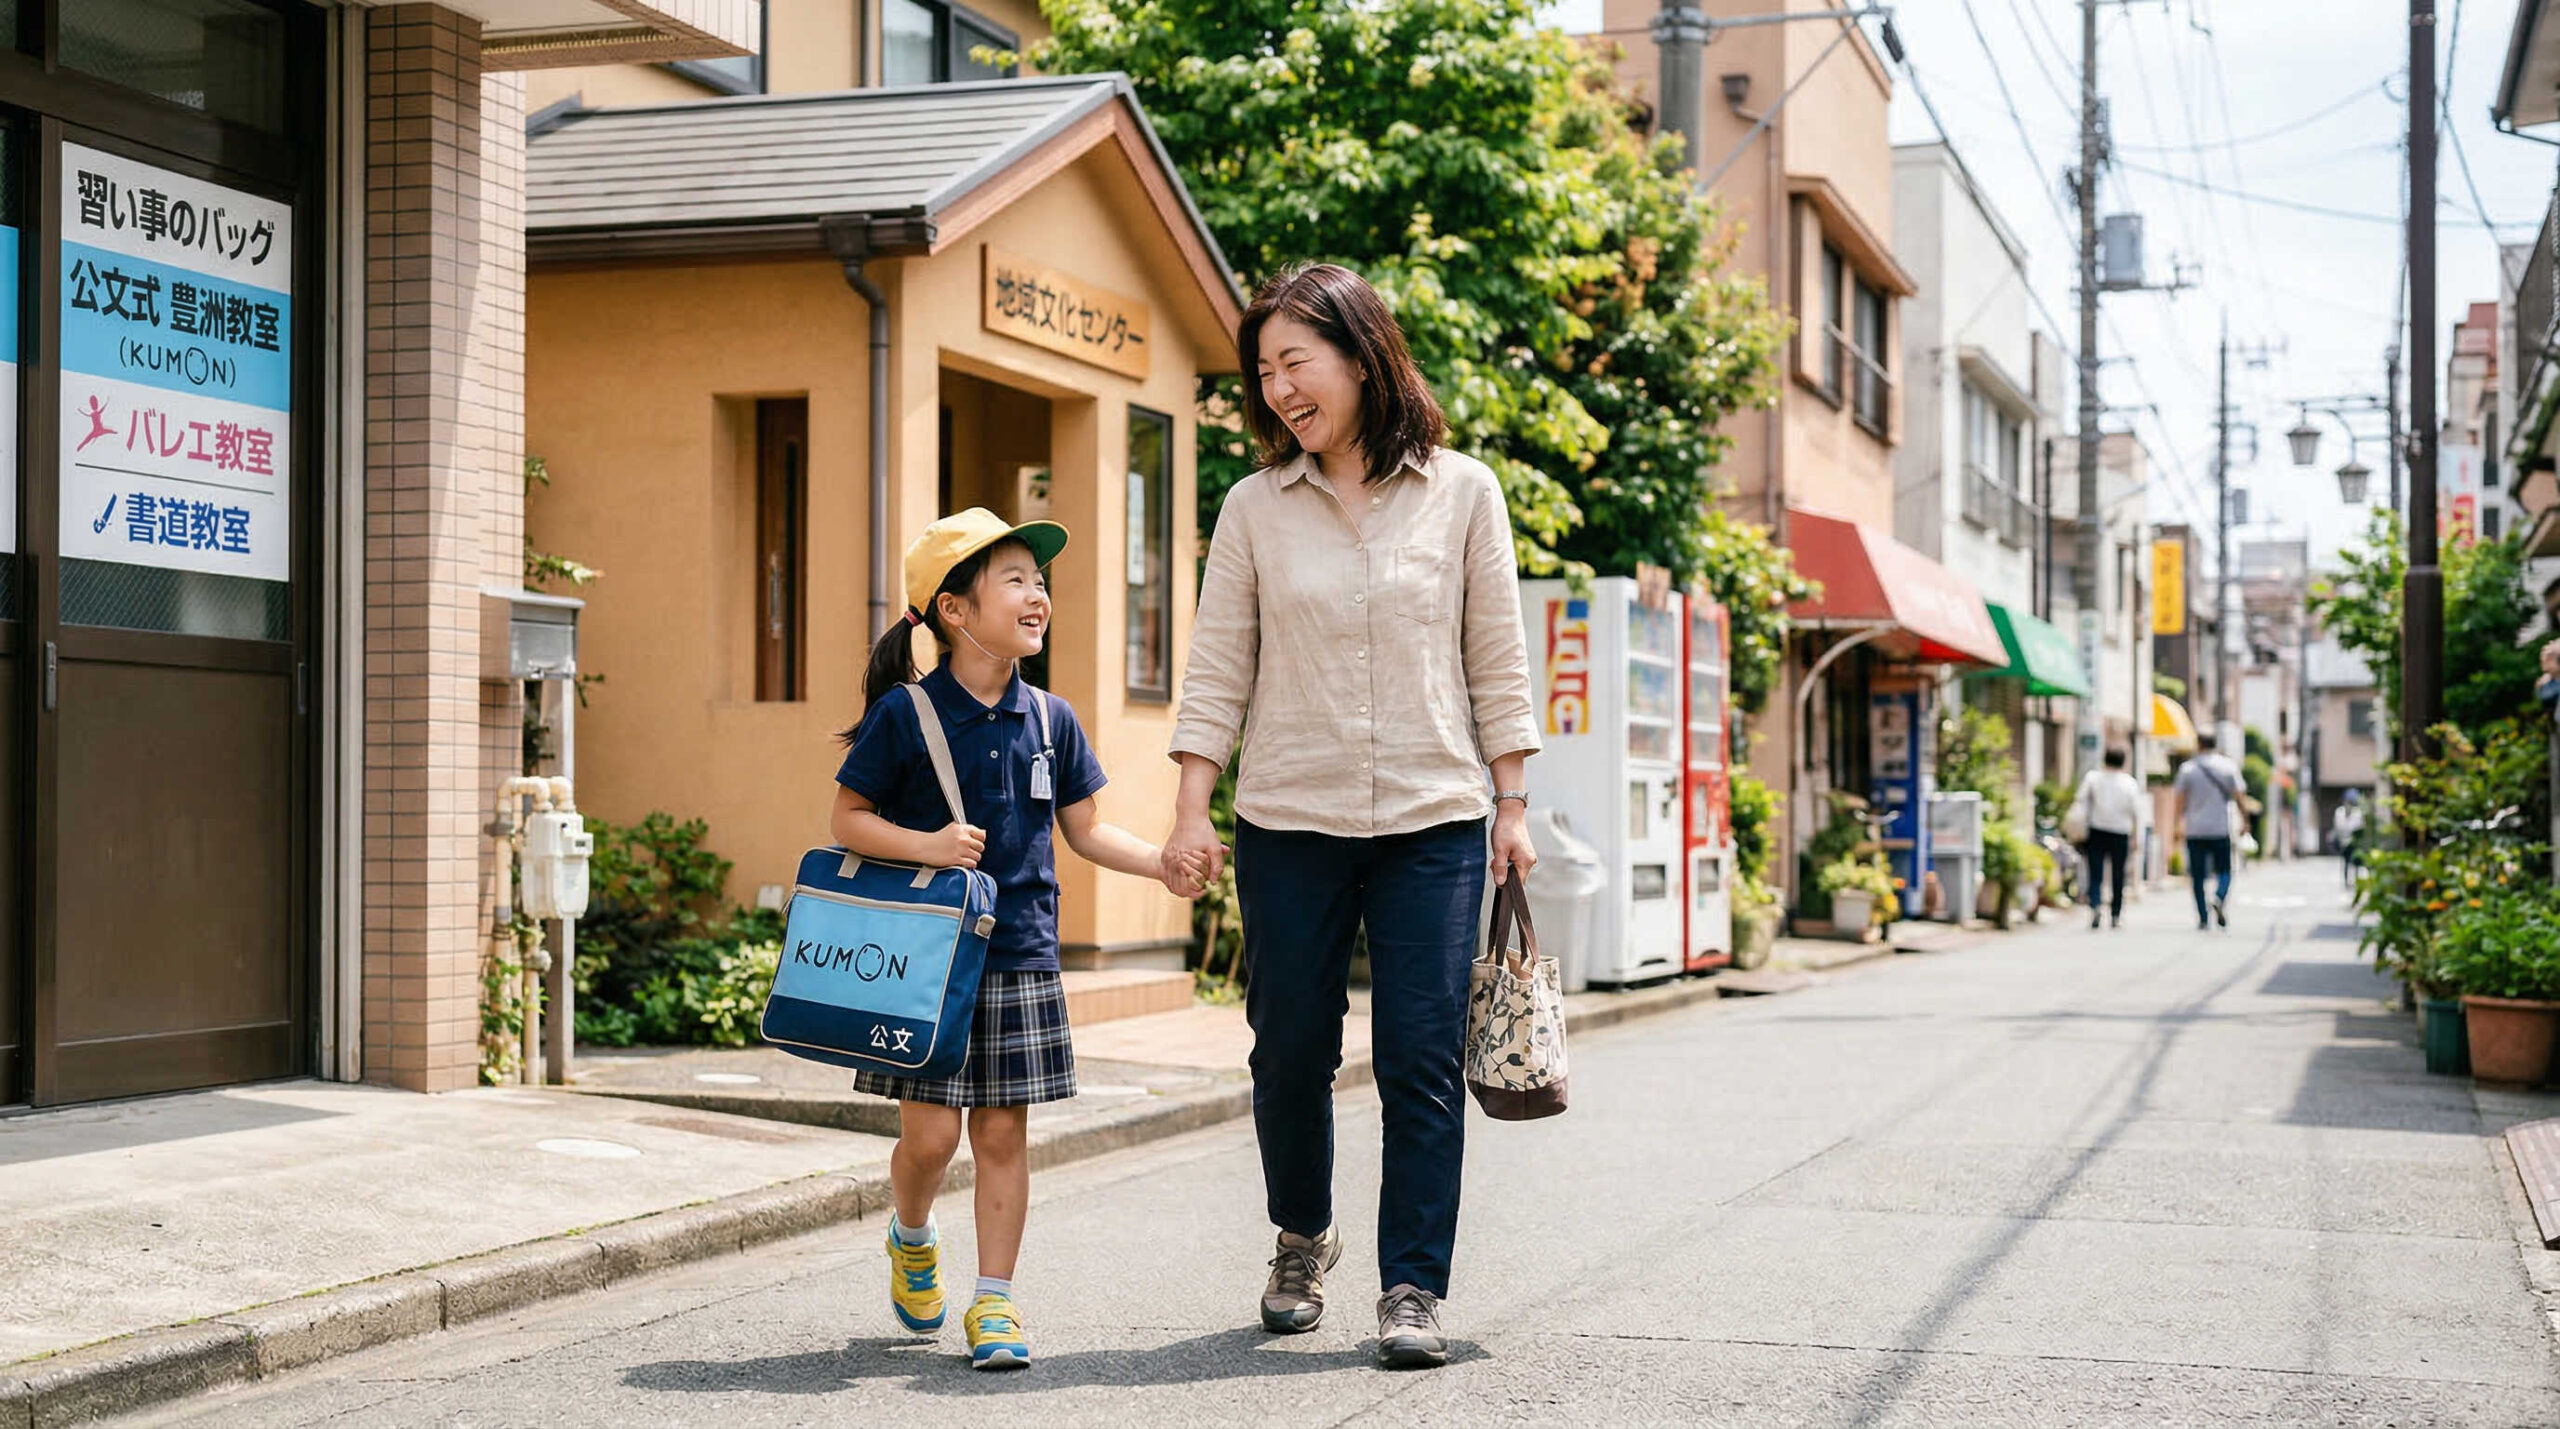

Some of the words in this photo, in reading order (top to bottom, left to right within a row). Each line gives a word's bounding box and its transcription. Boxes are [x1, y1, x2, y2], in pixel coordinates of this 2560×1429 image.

[77, 170, 275, 266] 習い事のバッグ
[70, 257, 161, 327] 公文式
[170, 282, 280, 353] 豊洲教室
[996, 267, 1143, 352] 地域文化センター
[126, 408, 274, 476] バレエ教室
[126, 492, 251, 555] 書道教室
[795, 940, 908, 982] KUMON
[870, 1024, 913, 1053] 公文
